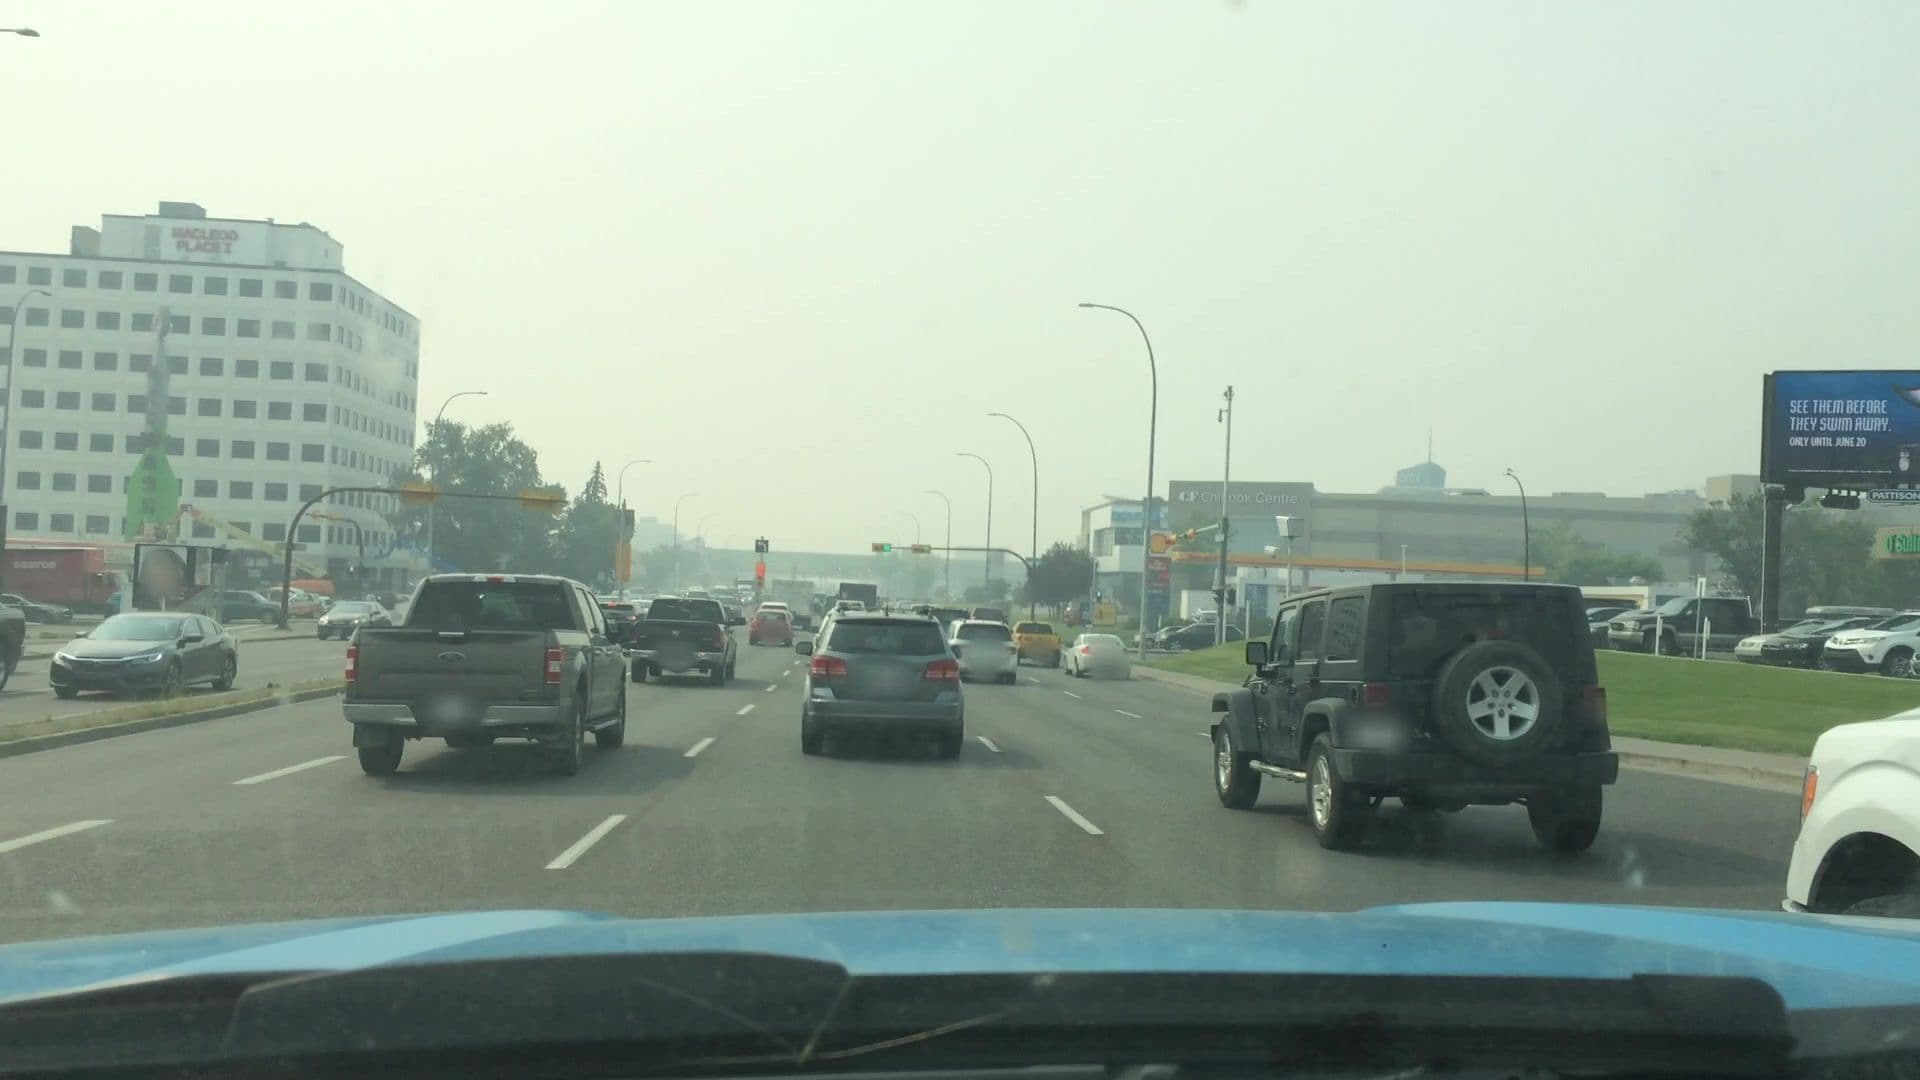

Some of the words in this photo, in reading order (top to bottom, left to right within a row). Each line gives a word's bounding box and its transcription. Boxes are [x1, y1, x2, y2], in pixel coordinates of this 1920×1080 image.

[172, 227, 239, 241] MACLEOD
[176, 240, 220, 253] PLACE
[1789, 399, 1809, 414] SEE
[1812, 399, 1844, 414] THEM
[1846, 400, 1888, 414] BEFORE
[1790, 417, 1817, 431] THEY
[1820, 417, 1852, 431] SWIM
[1854, 417, 1892, 432] AWAY.
[1789, 437, 1808, 447] ONLY
[1811, 437, 1833, 447] UNTIL
[1835, 437, 1855, 447] JUNE
[1856, 437, 1867, 447] 20
[1201, 491, 1249, 504] Chiook
[1256, 491, 1297, 504] Centre
[1872, 491, 1920, 500] PATTISON
